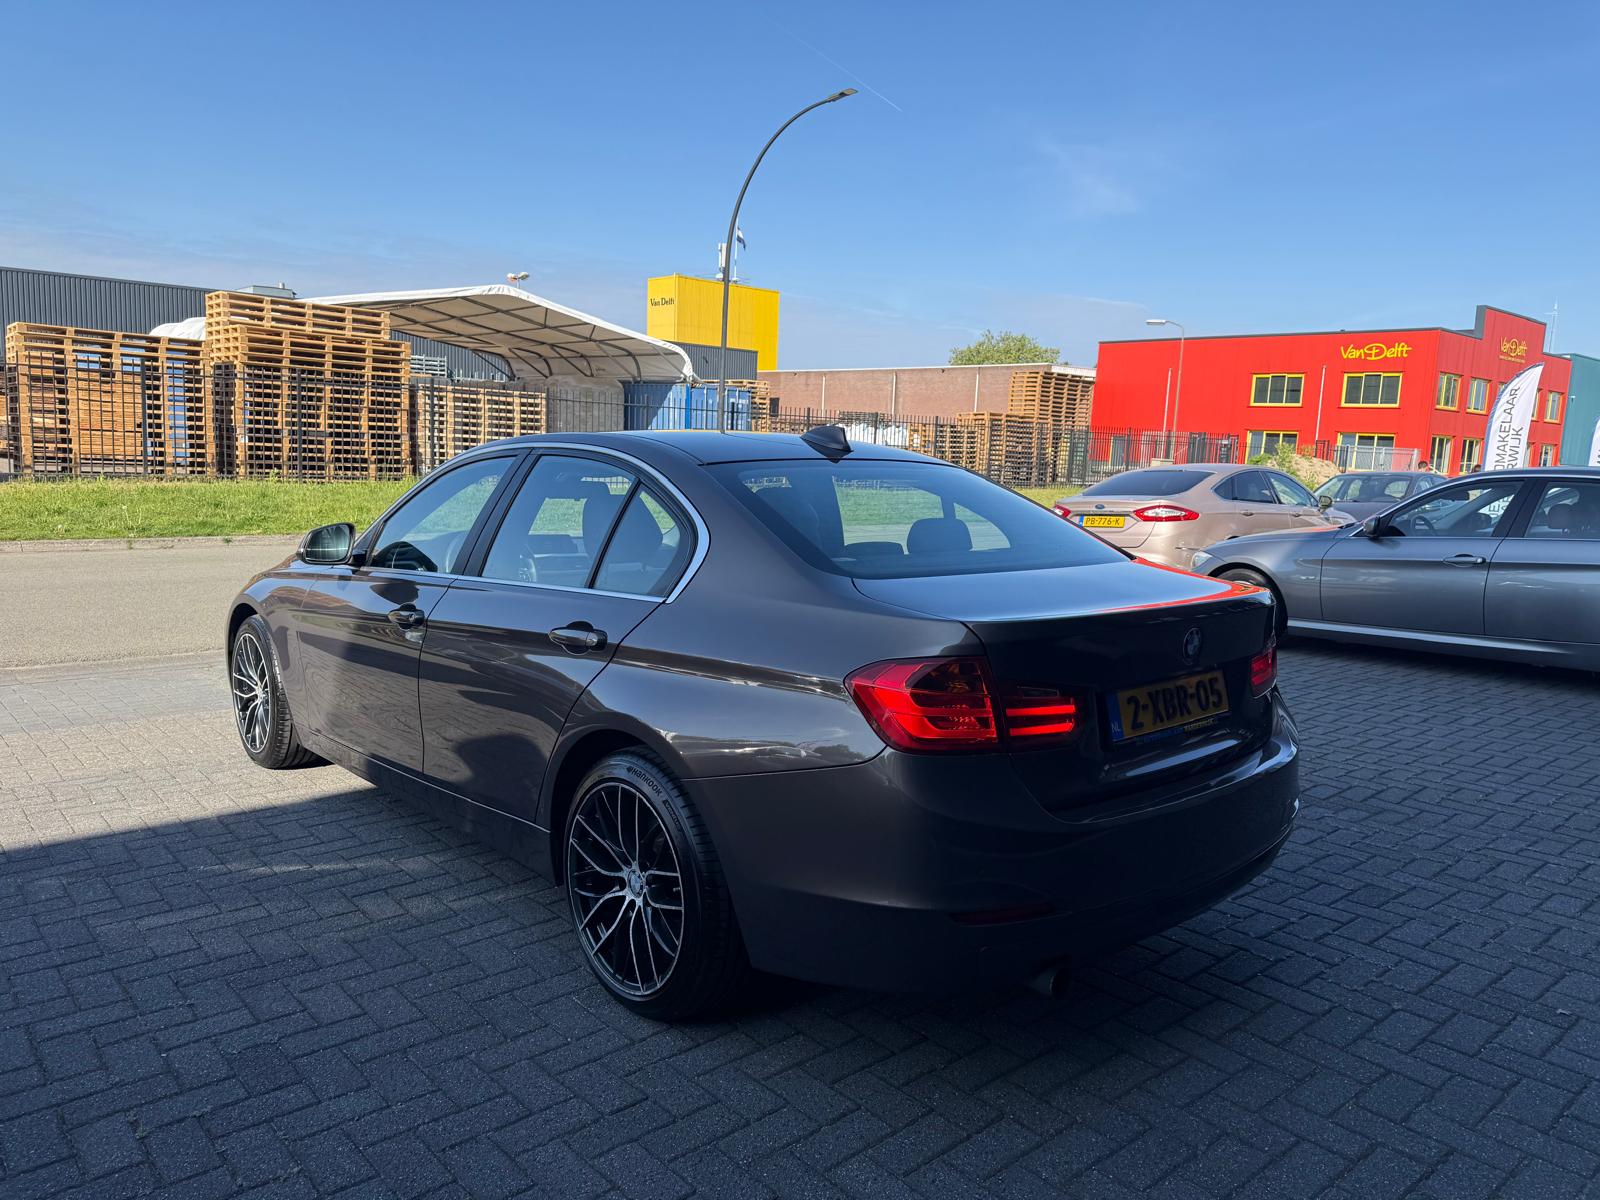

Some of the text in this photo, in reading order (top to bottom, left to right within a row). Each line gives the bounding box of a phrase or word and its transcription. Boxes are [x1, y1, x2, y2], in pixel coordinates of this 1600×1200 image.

[650, 298, 660, 307] Van
[1340, 342, 1412, 360] Van Delft
[1085, 517, 1120, 526] PB-776-K
[1126, 677, 1223, 731] 2-XBR-05
